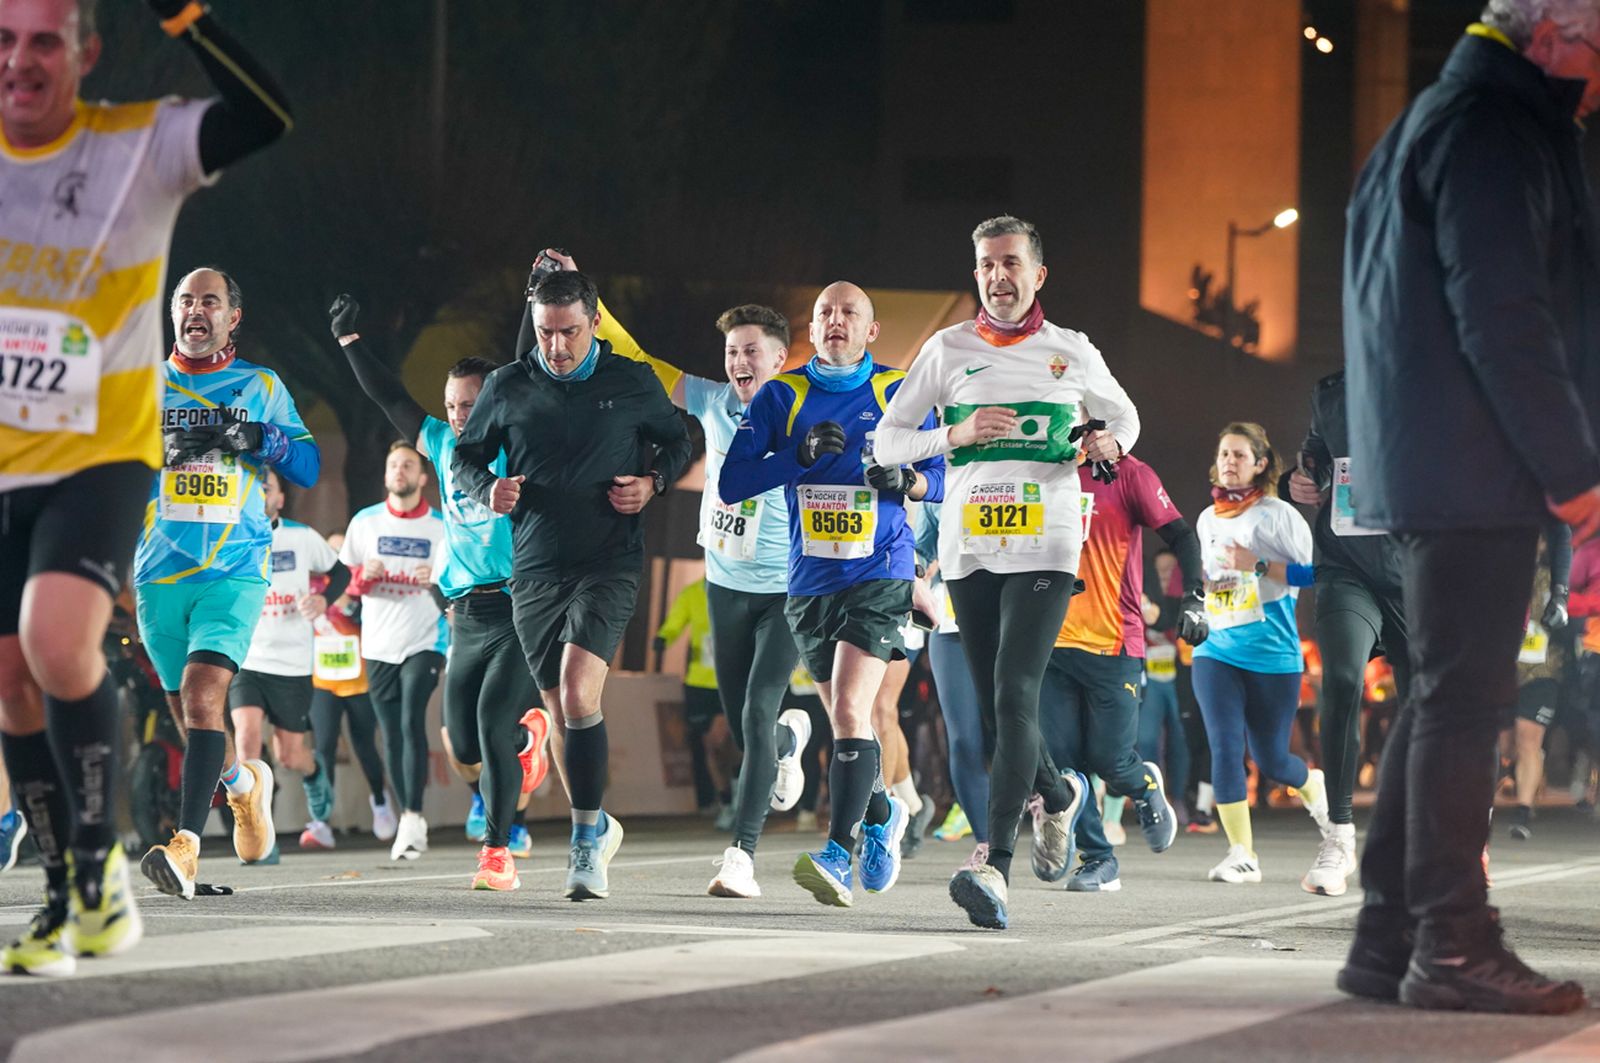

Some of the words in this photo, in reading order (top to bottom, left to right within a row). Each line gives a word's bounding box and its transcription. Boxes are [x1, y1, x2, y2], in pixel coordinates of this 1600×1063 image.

[161, 408, 248, 426] EPORTVO
[175, 473, 228, 497] 6965
[979, 485, 1004, 494] NOCHE
[1005, 485, 1015, 493] DE
[814, 493, 836, 501] NOCHE
[969, 495, 985, 504] SAN
[807, 501, 820, 509] SAN
[812, 511, 863, 534] 8563
[979, 504, 1027, 528] 3121
